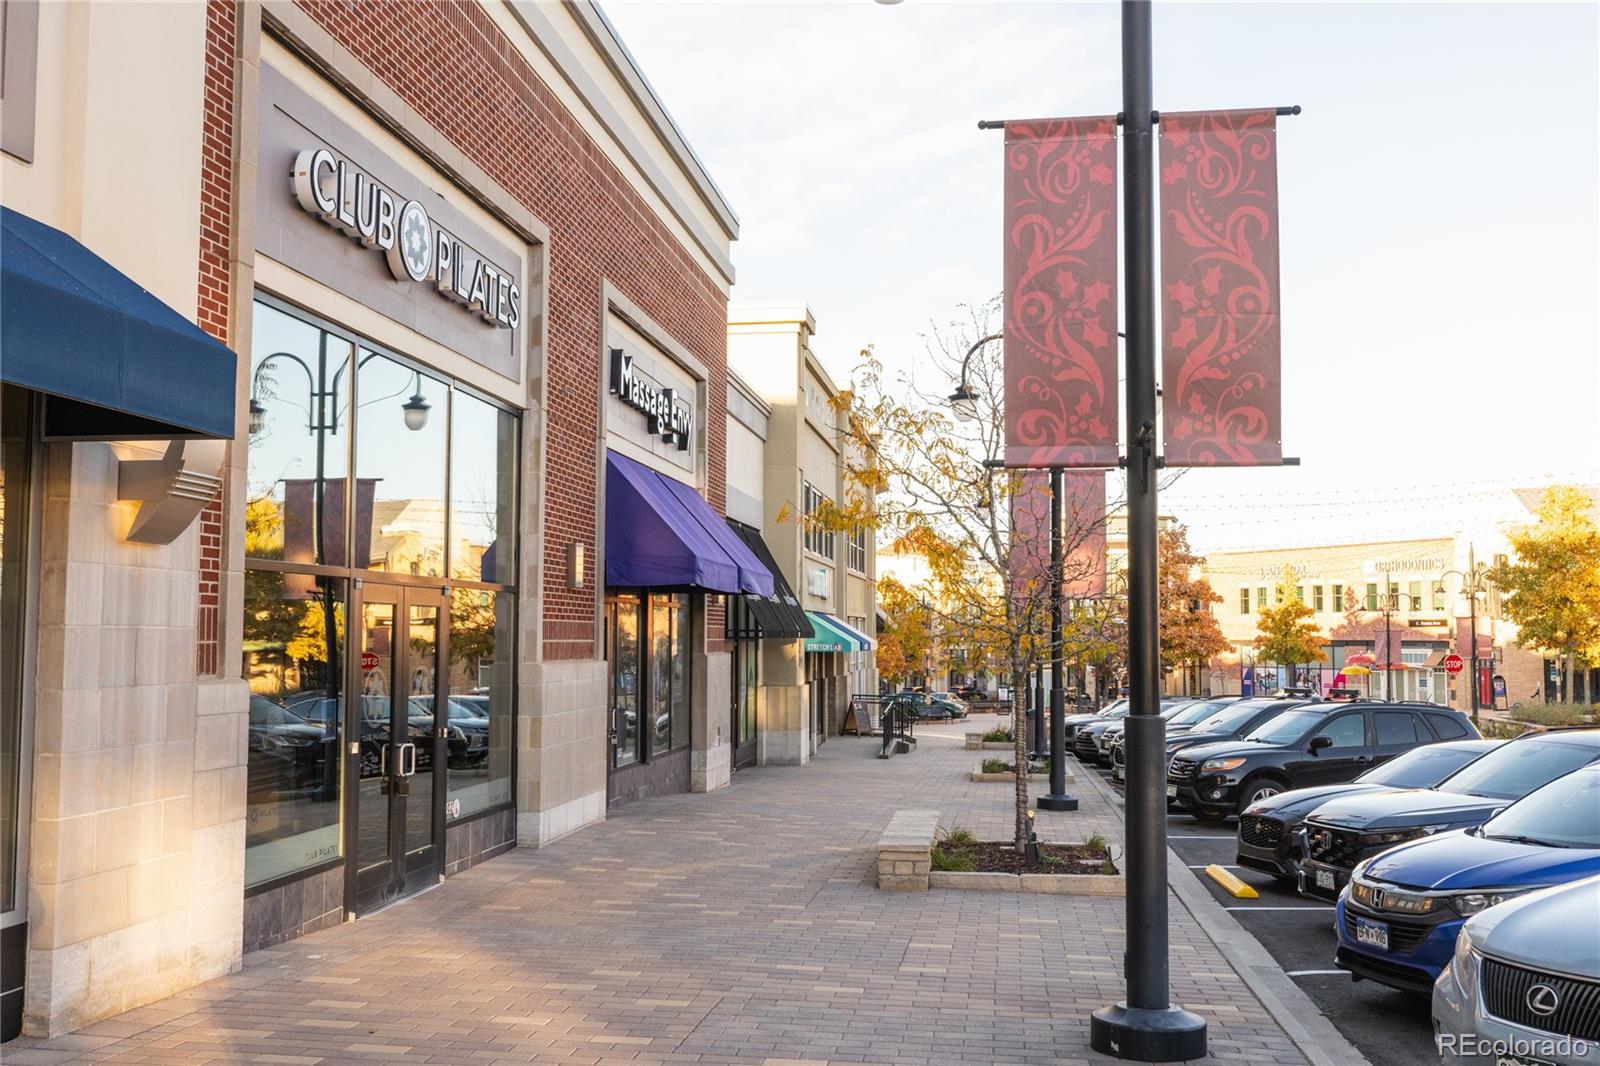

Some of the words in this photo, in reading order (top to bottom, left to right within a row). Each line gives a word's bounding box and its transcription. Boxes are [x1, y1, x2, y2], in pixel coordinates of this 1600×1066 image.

[306, 148, 395, 252] CLUB
[435, 231, 521, 330] PILATES
[615, 351, 669, 435] Massage
[669, 388, 693, 452] Envy
[1375, 558, 1445, 572] ORTHODONTICS
[1445, 660, 1463, 669] STOP
